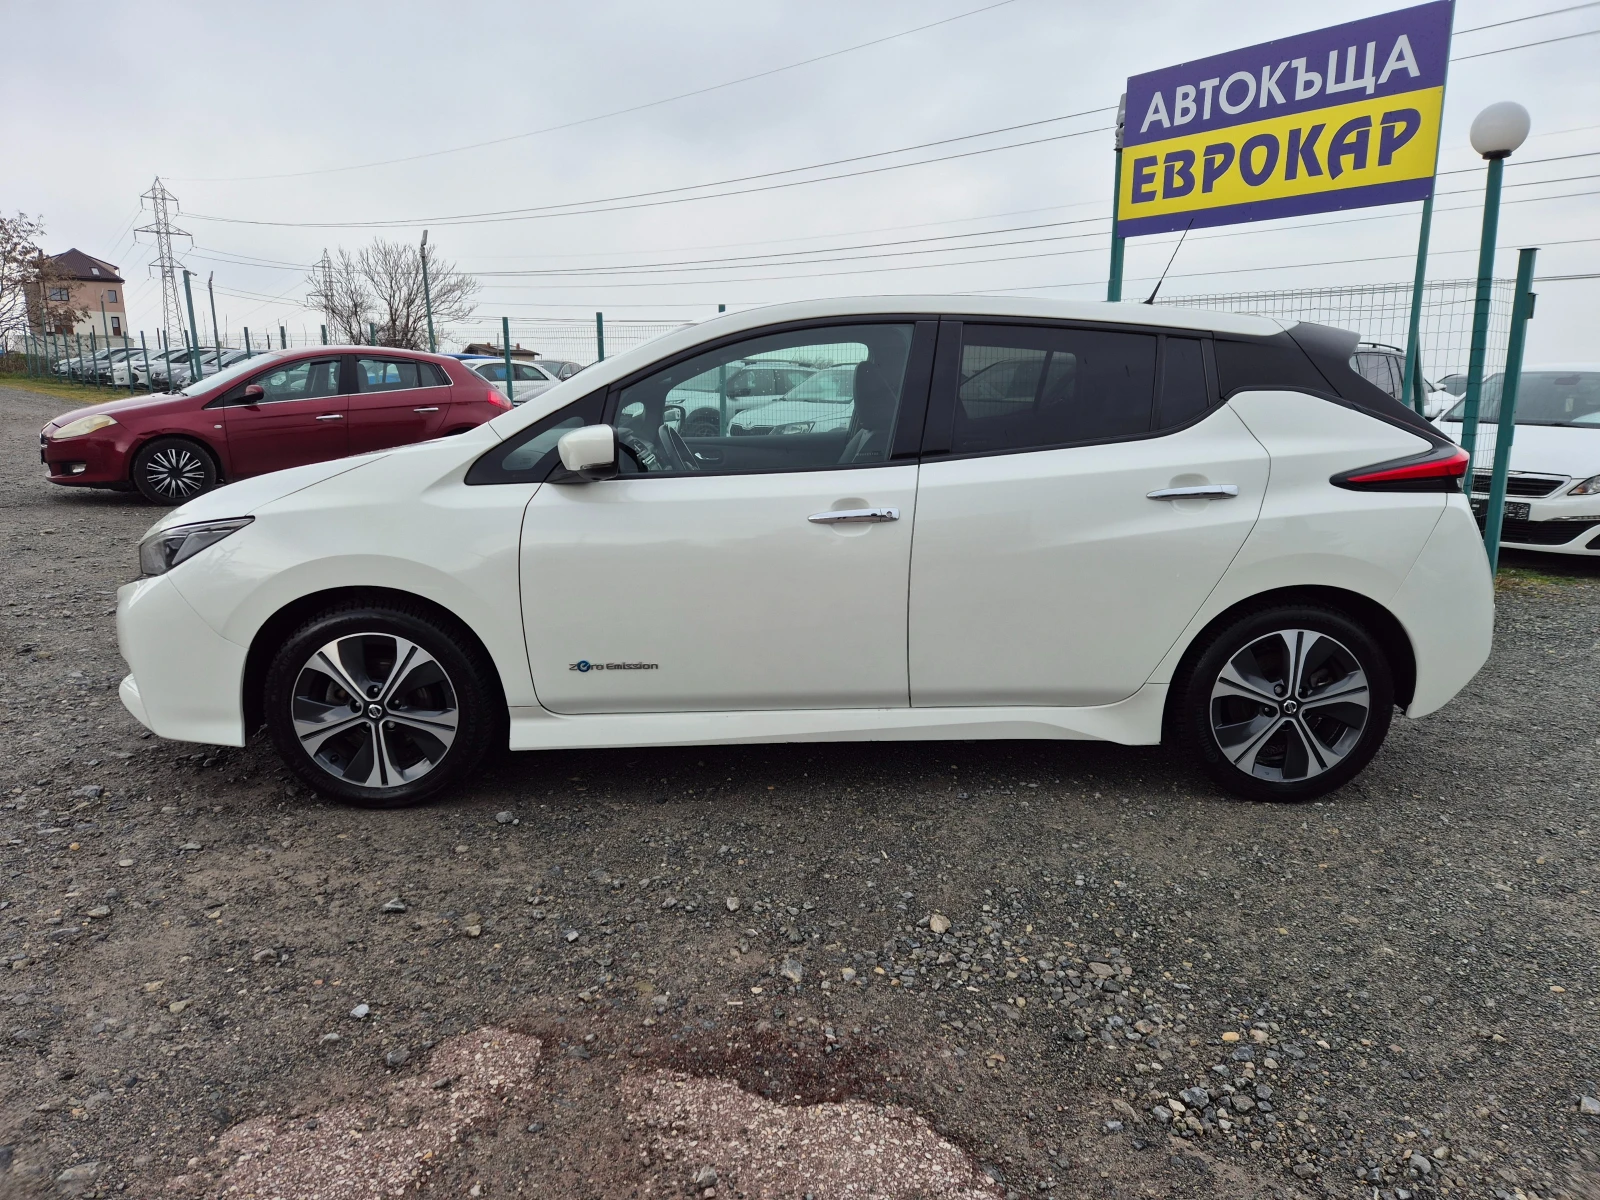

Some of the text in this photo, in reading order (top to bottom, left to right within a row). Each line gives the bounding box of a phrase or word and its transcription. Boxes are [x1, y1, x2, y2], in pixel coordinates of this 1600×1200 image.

[1140, 34, 1420, 133] АВТОКЪЩА
[1131, 107, 1421, 204] ЕВРОКАР
[605, 661, 659, 670] Emission
